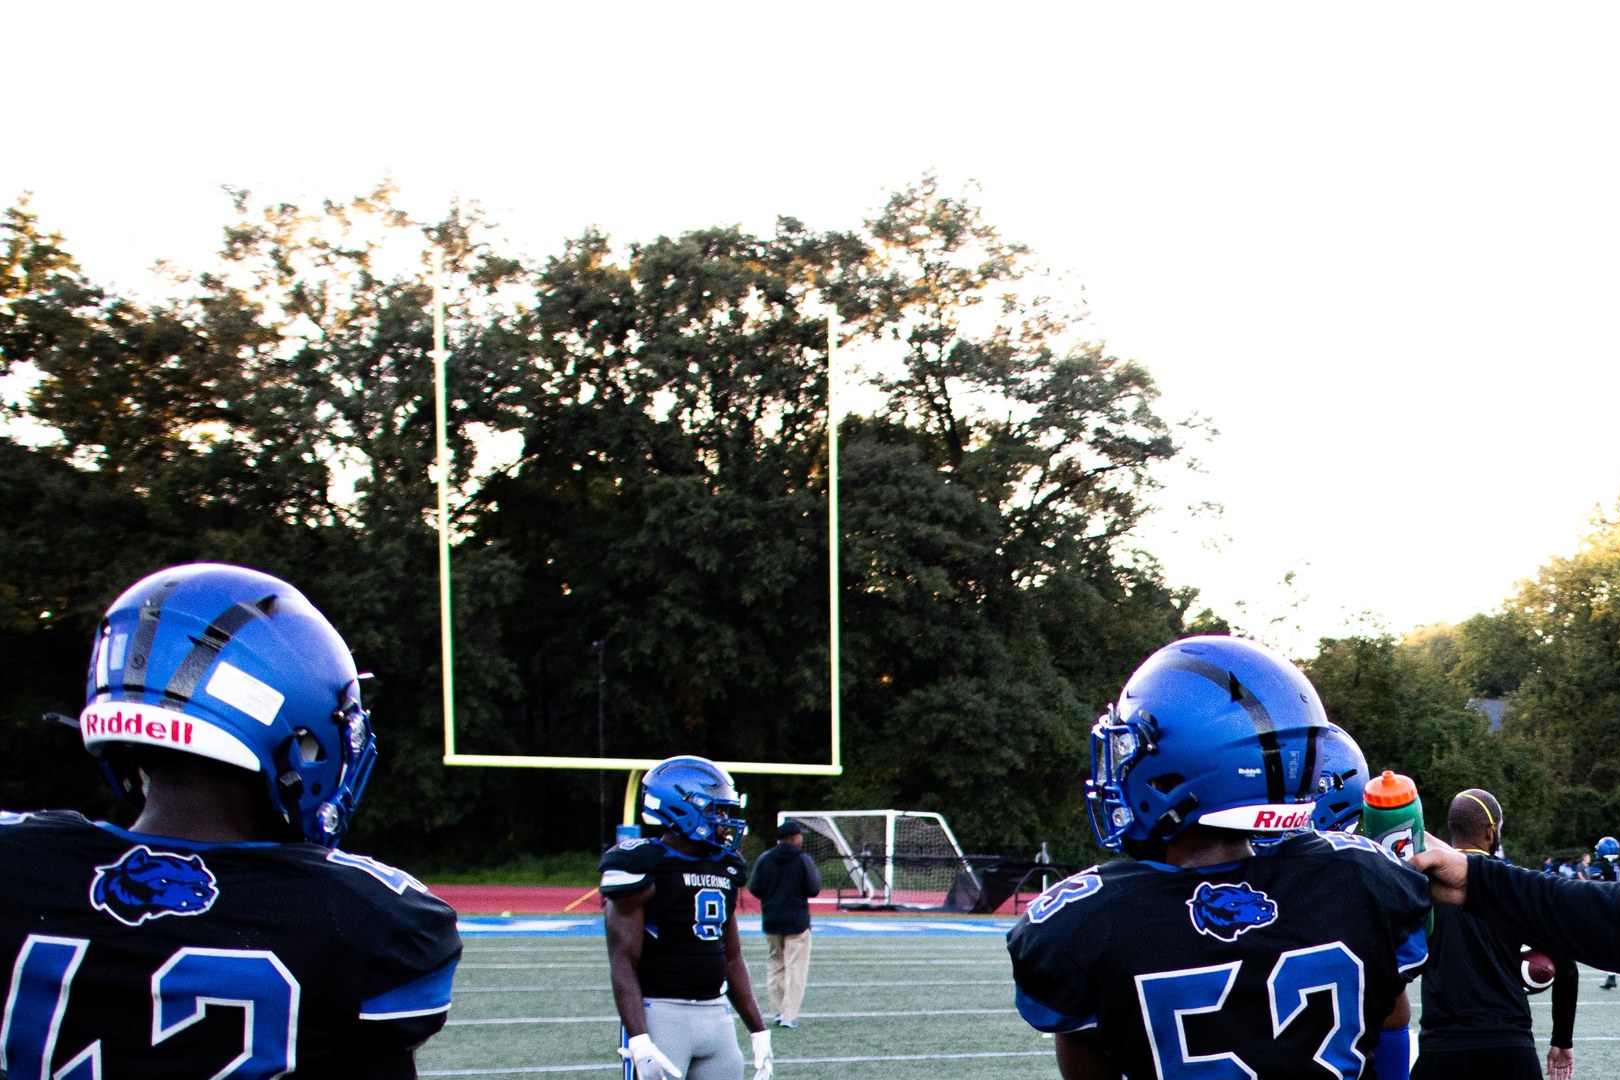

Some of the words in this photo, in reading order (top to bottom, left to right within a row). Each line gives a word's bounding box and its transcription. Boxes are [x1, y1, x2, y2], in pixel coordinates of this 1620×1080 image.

[86, 711, 193, 745] Riddell
[1253, 811, 1308, 828] Ridd
[683, 872, 731, 890] WOLVERINES
[692, 888, 727, 940] 8
